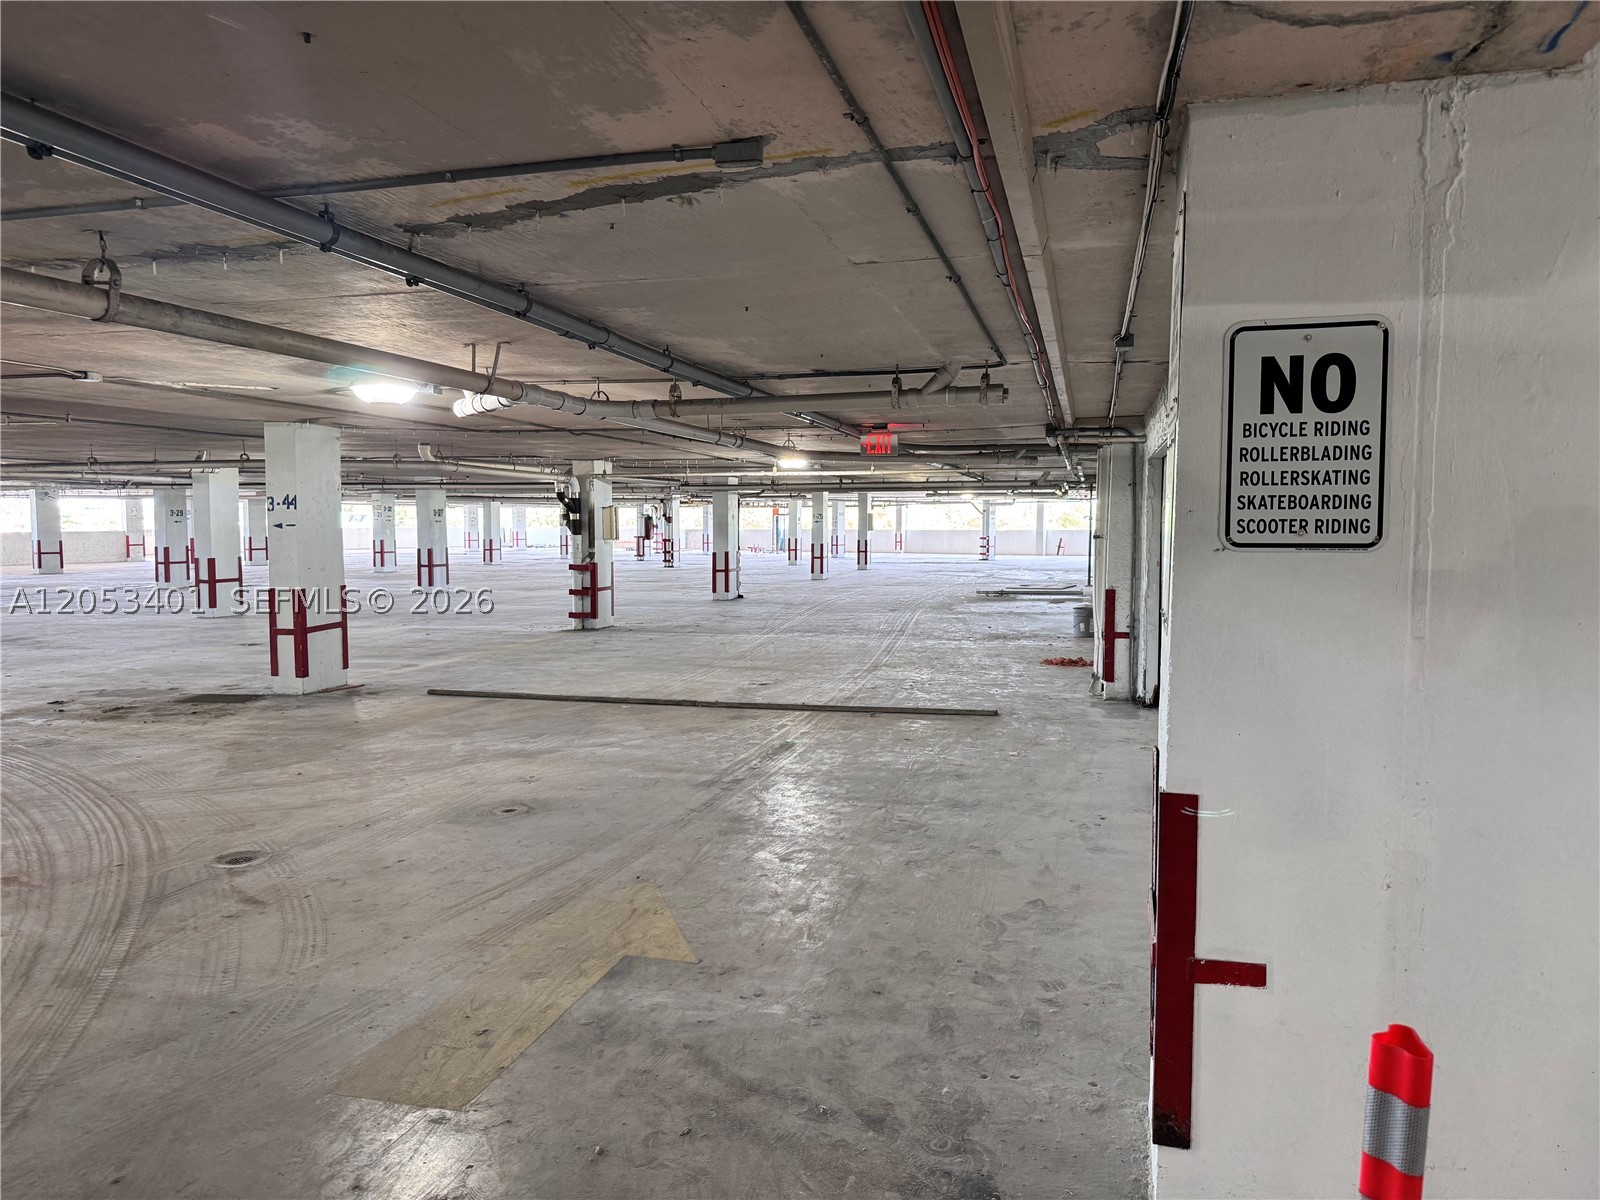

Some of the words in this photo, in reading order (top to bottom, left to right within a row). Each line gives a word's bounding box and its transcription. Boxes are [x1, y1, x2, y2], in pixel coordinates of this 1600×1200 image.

[1260, 353, 1357, 414] NO
[1242, 421, 1308, 438] BICYCLE
[1313, 420, 1371, 437] RIDING
[866, 433, 893, 454] EXIT
[1239, 445, 1372, 462] ROLLERBLADING
[1239, 469, 1371, 486] ROLLERSKATING
[267, 494, 297, 512] 3-44
[1236, 494, 1372, 511] SKATEBOARDING
[169, 509, 184, 517] 3-29
[1236, 518, 1309, 534] SCOOTER
[1314, 518, 1371, 534] RIDING
